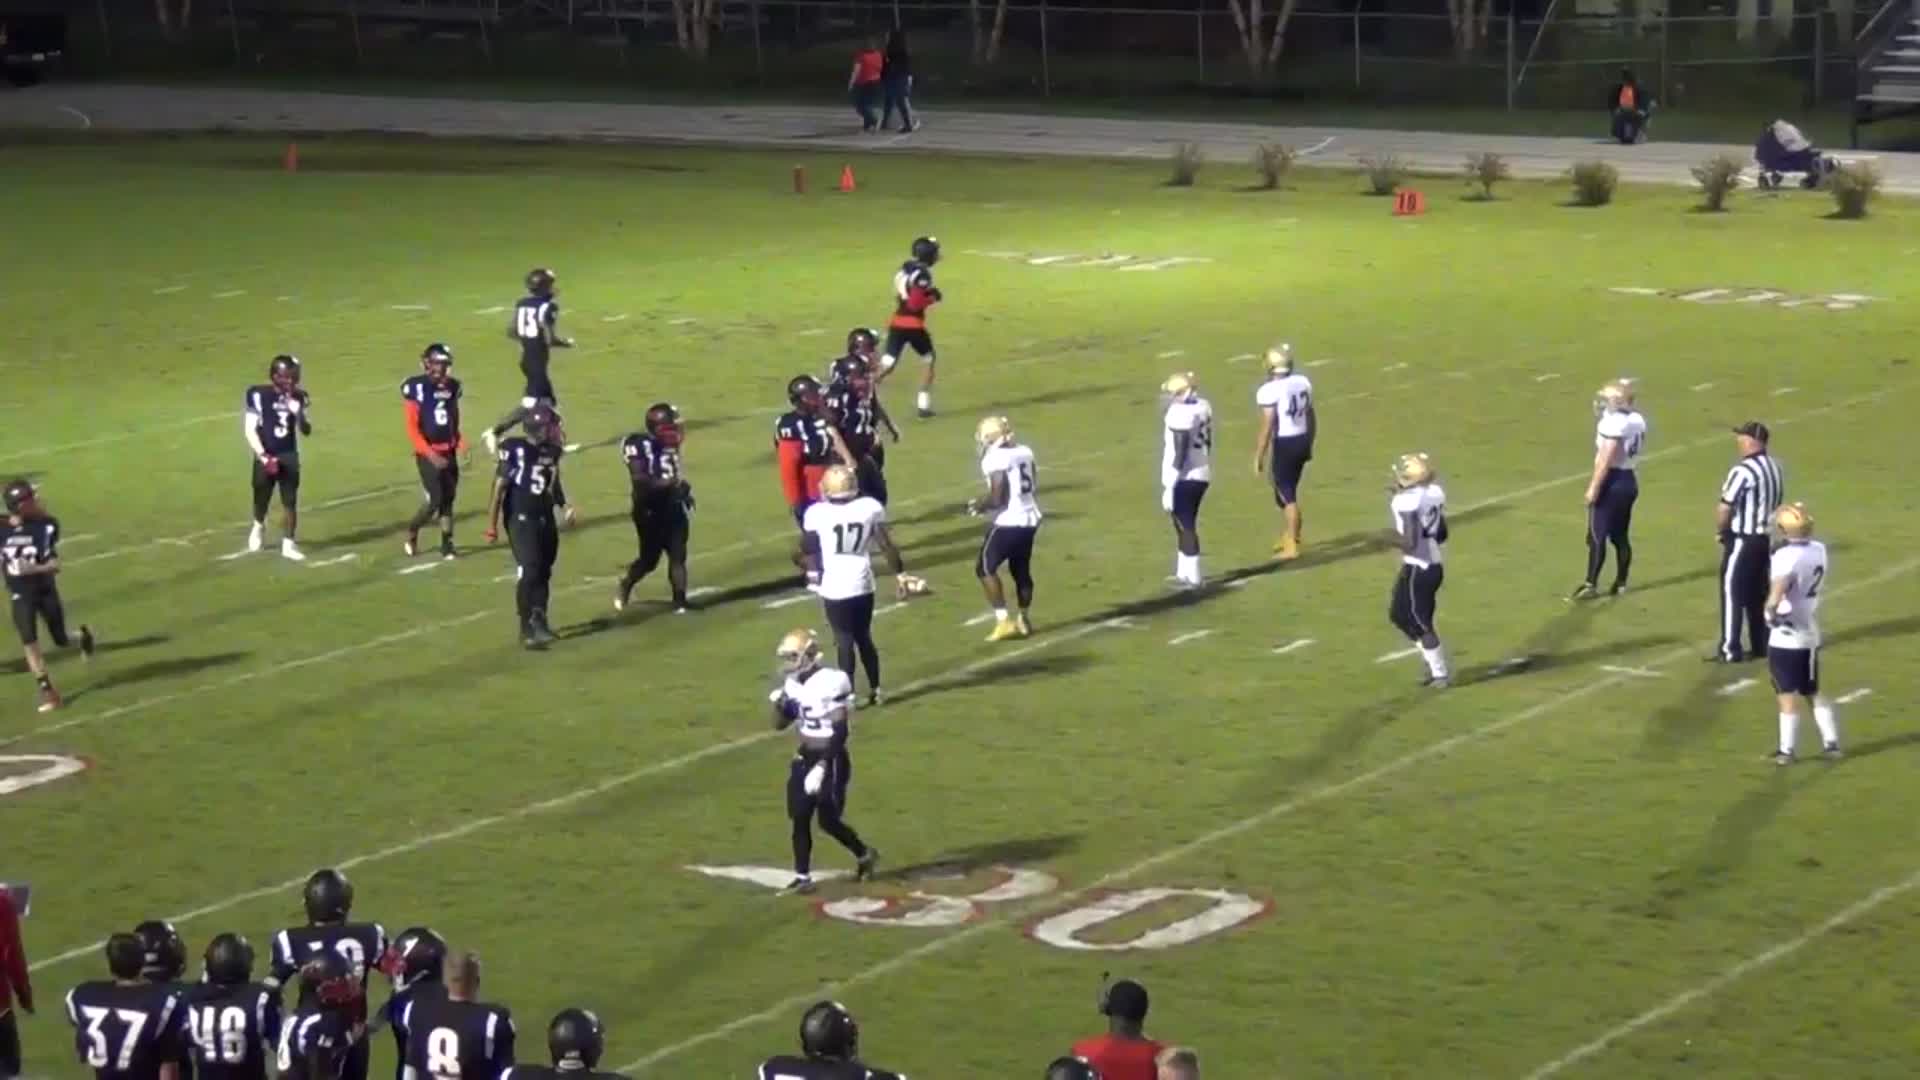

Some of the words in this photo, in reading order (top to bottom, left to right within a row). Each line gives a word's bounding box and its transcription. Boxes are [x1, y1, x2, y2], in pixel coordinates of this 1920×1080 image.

[1397, 193, 1415, 211] 10
[517, 306, 538, 338] 13
[274, 411, 288, 438] 3
[434, 401, 448, 426] 6
[832, 523, 864, 554] 17
[1805, 565, 1822, 598] 2
[818, 866, 1268, 951] 30
[81, 1005, 147, 1070] 37
[187, 1006, 247, 1062] 48
[427, 1027, 460, 1075] 8
